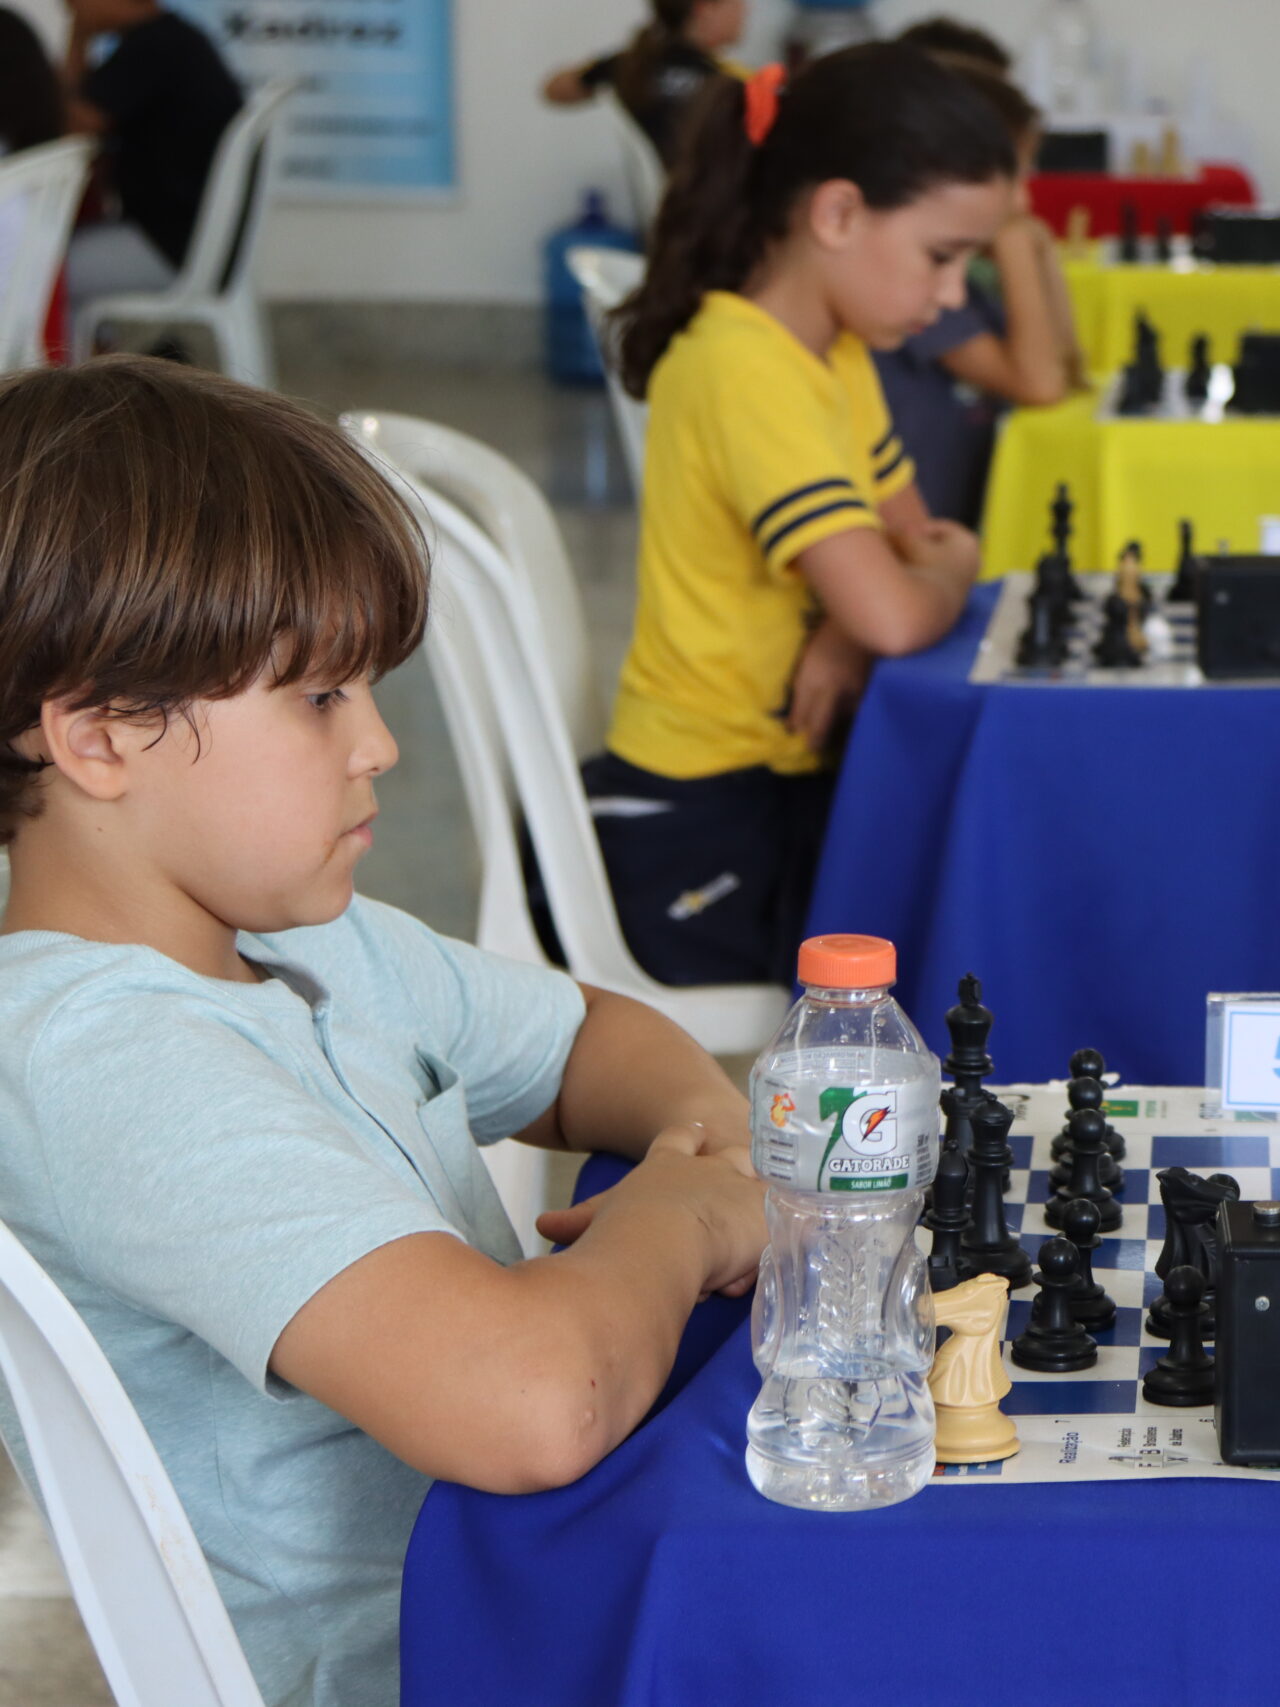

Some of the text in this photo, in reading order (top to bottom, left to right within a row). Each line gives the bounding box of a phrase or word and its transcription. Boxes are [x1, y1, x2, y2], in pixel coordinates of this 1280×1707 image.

[828, 1154, 910, 1173] GATORADE
[850, 1180, 872, 1190] SABOR
[1059, 1431, 1081, 1464] Realização
